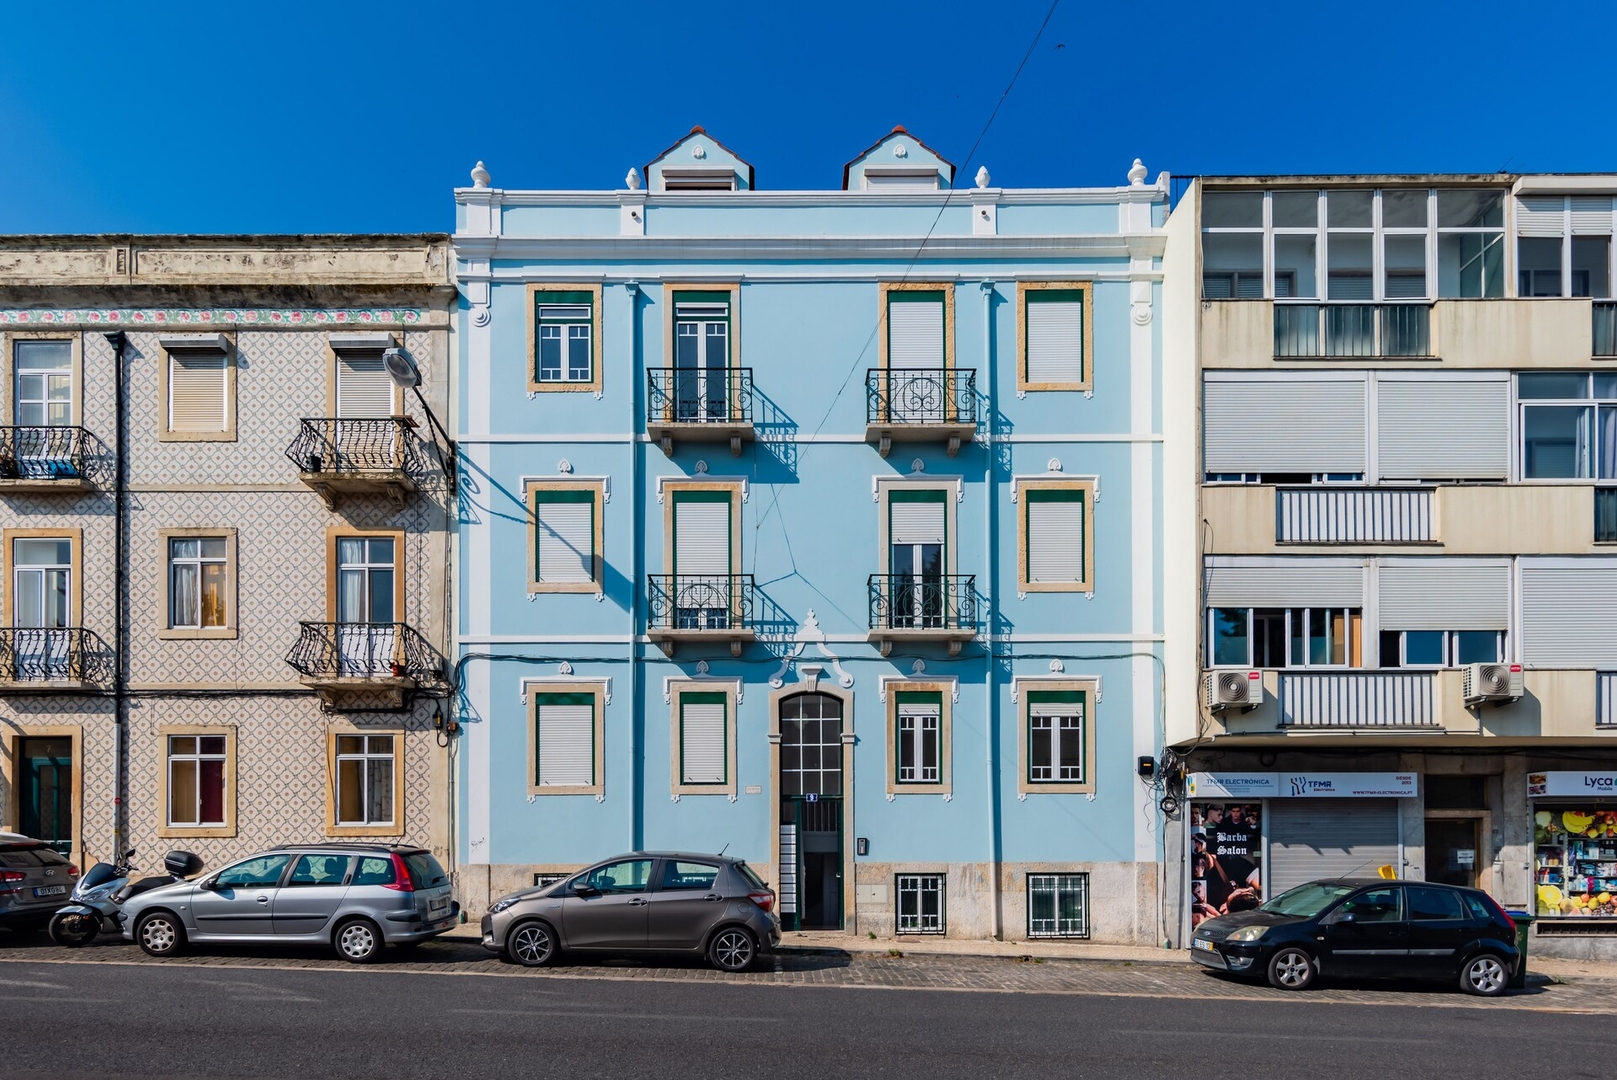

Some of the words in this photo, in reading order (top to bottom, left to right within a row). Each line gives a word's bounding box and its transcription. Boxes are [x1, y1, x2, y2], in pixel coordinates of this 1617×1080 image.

[1585, 776, 1613, 788] Lyca
[1217, 832, 1247, 842] Barba
[1217, 846, 1247, 855] Salon
